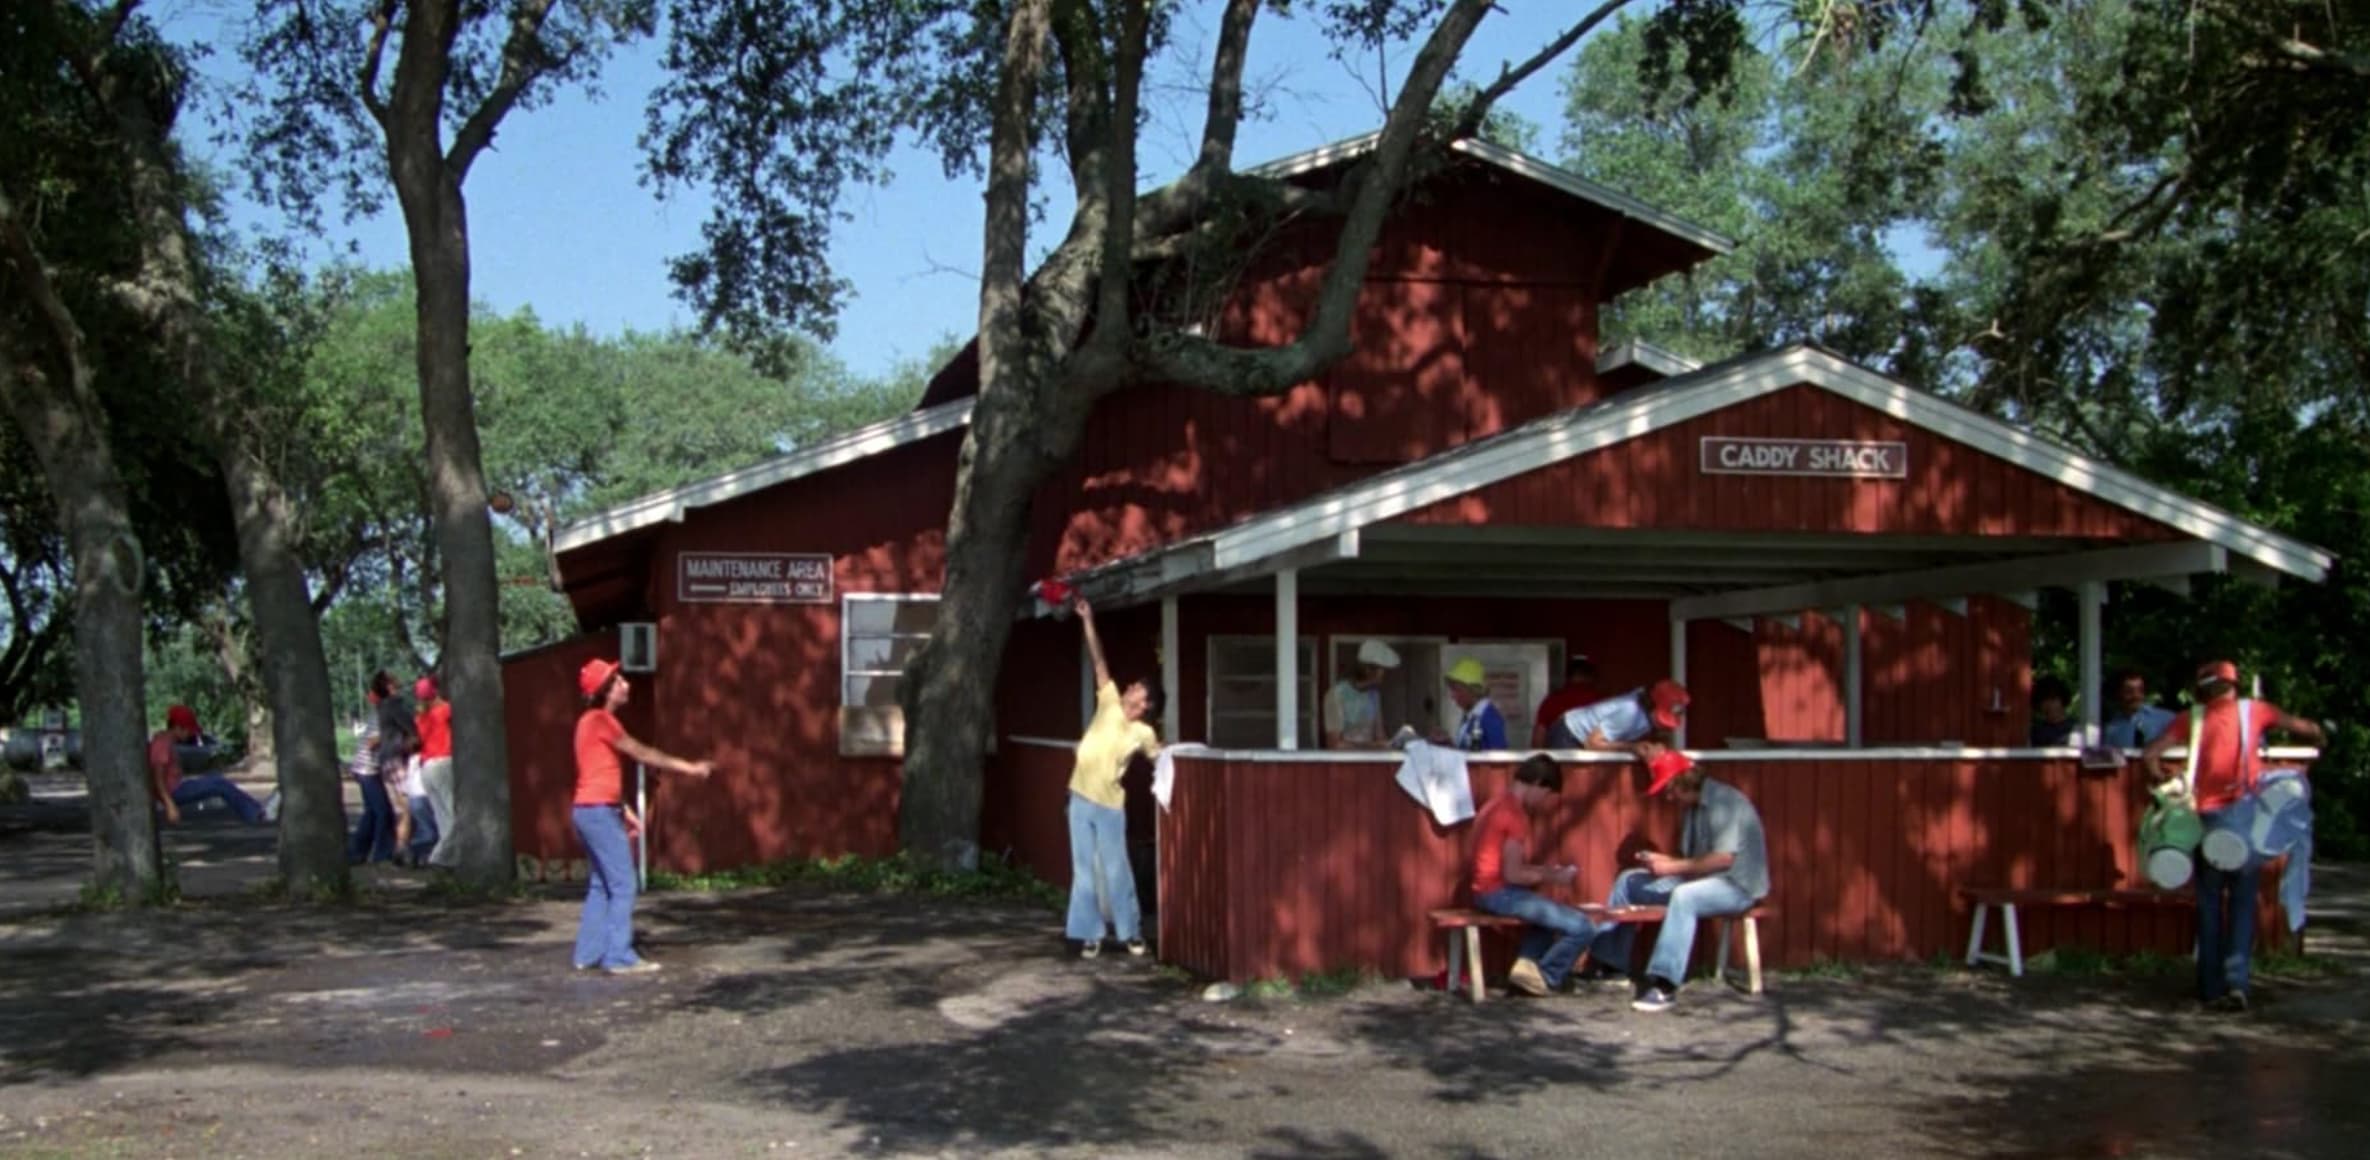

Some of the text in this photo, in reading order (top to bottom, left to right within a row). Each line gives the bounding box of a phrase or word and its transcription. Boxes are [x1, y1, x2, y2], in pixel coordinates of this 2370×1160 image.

[1720, 444, 1891, 470] CADDY SHACK
[686, 559, 825, 579] MAINTENANCE AREA
[729, 581, 825, 597] EMPLOYEES ONLY
